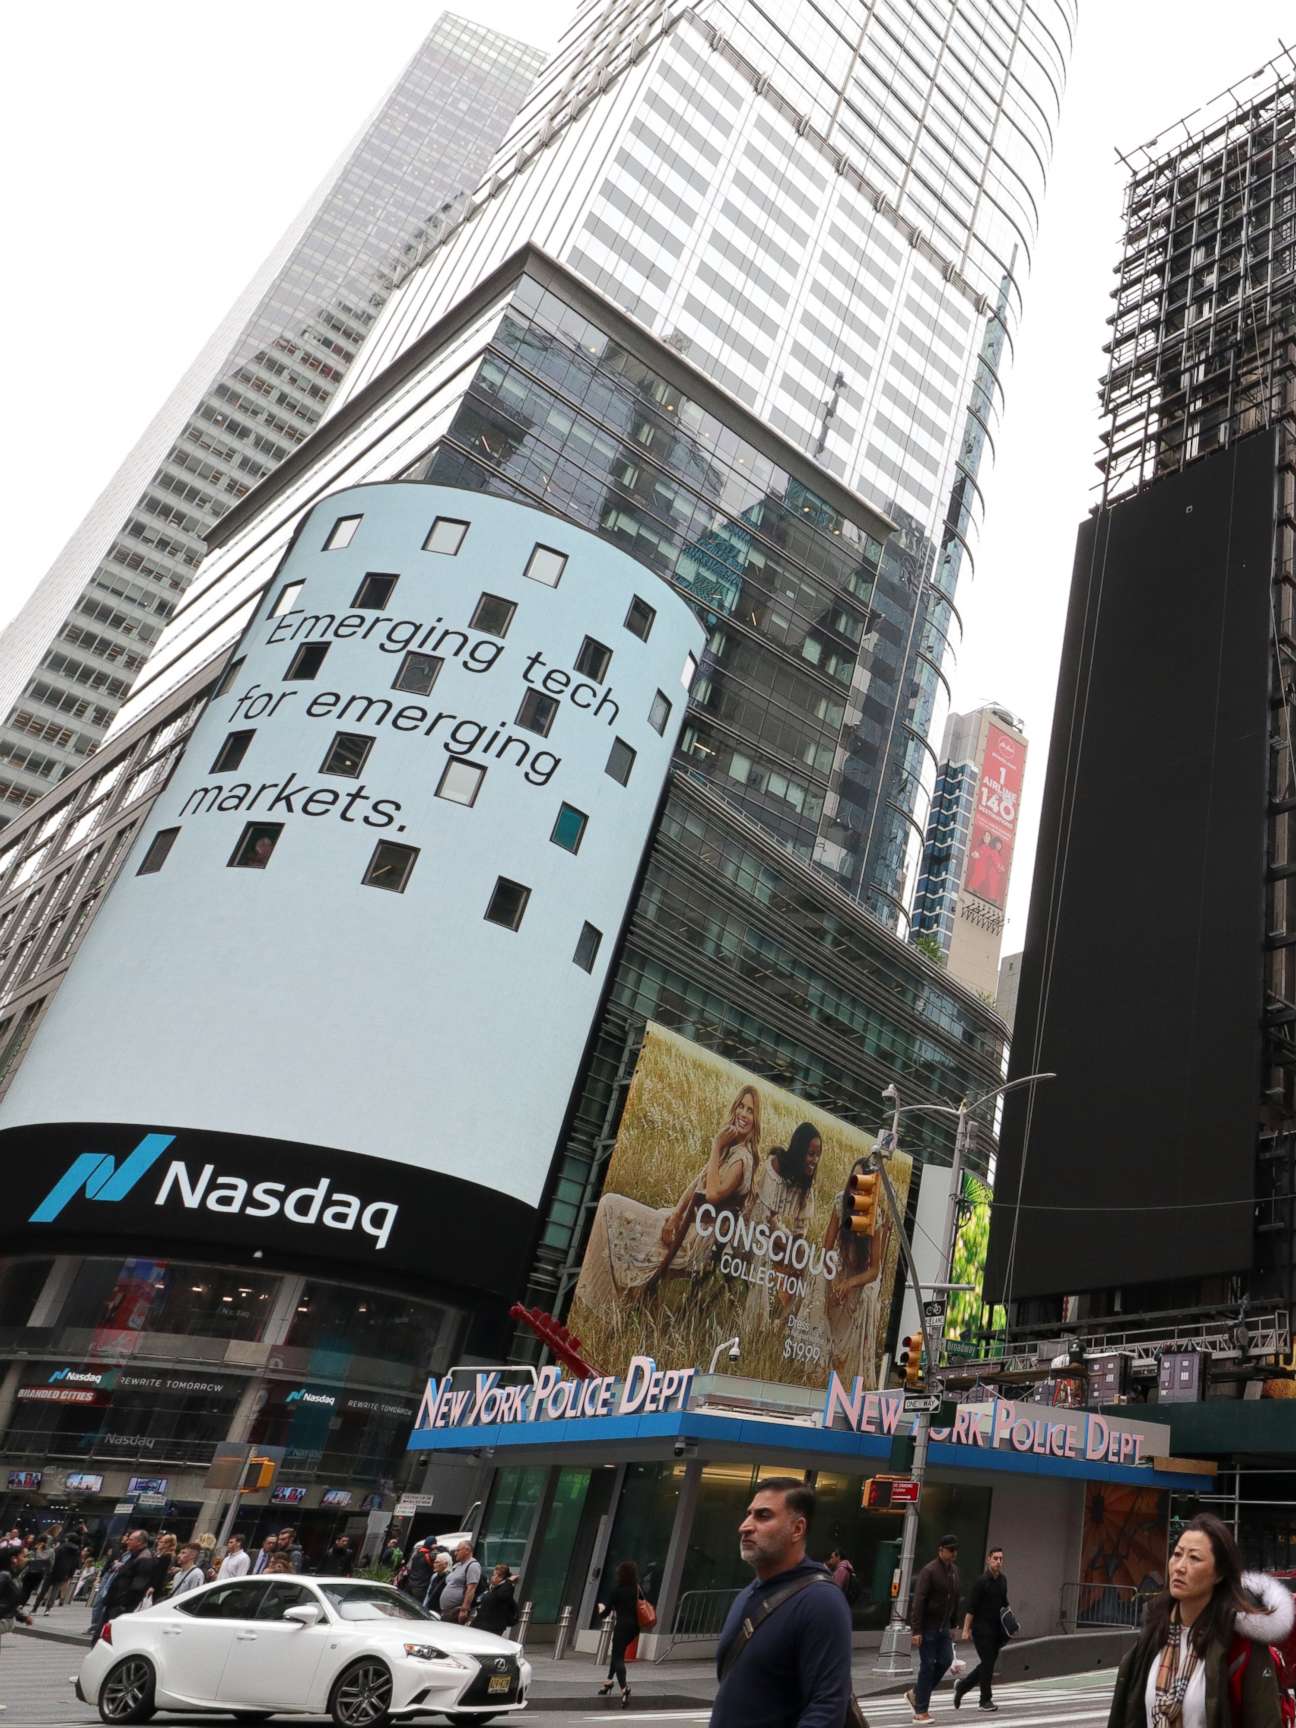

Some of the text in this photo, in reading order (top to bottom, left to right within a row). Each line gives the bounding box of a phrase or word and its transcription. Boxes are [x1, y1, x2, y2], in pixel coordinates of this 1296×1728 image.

[266, 607, 621, 727] Emerging tech
[227, 682, 563, 787] for emerging
[178, 772, 408, 834] markets.
[981, 786, 1015, 821] 140
[154, 1160, 399, 1250] Nasdaq
[695, 1203, 840, 1281] CONSCIOUS
[720, 1254, 807, 1298] COLLECTION
[788, 1314, 809, 1331] Dress
[783, 1339, 820, 1363] $19.99
[18, 1388, 95, 1402] BRANDED CITIES
[65, 1370, 102, 1385] Nasdaq
[120, 1376, 225, 1393] REWRITE TOMORROW
[414, 1355, 698, 1429] NEW YORK POLICE DEPT
[302, 1392, 336, 1407] Nasdaq
[823, 1370, 904, 1433] NEW
[993, 1398, 1077, 1459] POLICE
[1085, 1413, 1146, 1465] DEPT
[906, 1399, 936, 1409] ONE WAY
